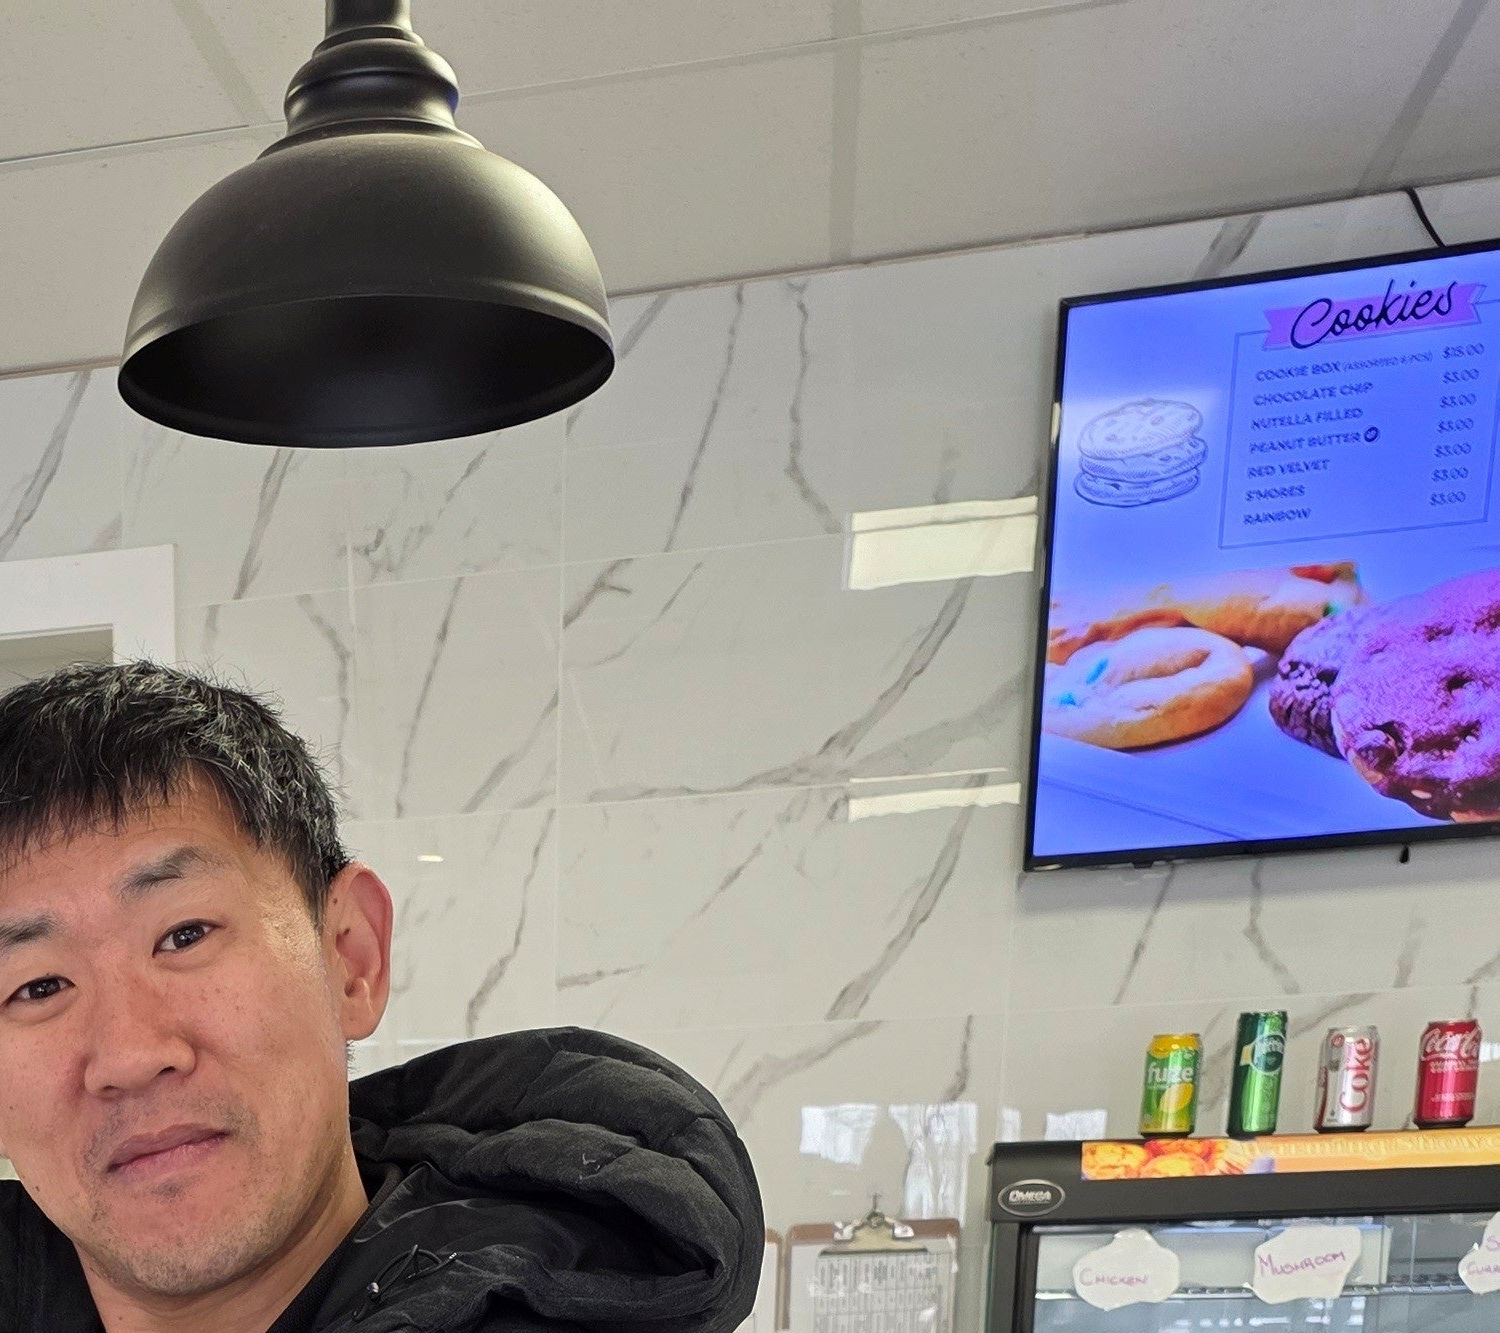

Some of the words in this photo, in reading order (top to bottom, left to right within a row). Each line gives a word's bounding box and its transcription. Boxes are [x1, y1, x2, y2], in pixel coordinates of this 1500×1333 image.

[1289, 279, 1457, 350] Cookies
[1256, 365, 1308, 382] COOKIE
[1311, 360, 1341, 375] BOX
[1252, 386, 1337, 406] CHOCOLATE
[1339, 381, 1374, 396] CHIP
[1250, 412, 1312, 430] NUTELLA
[1315, 408, 1364, 424] FILLED
[1249, 437, 1305, 454] PEANUT
[1307, 431, 1361, 448] BUTTER
[1246, 464, 1276, 479] RED
[1278, 458, 1330, 475] VELVET
[1242, 508, 1311, 525] RAINBOW
[1340, 1037, 1373, 1113] Coke
